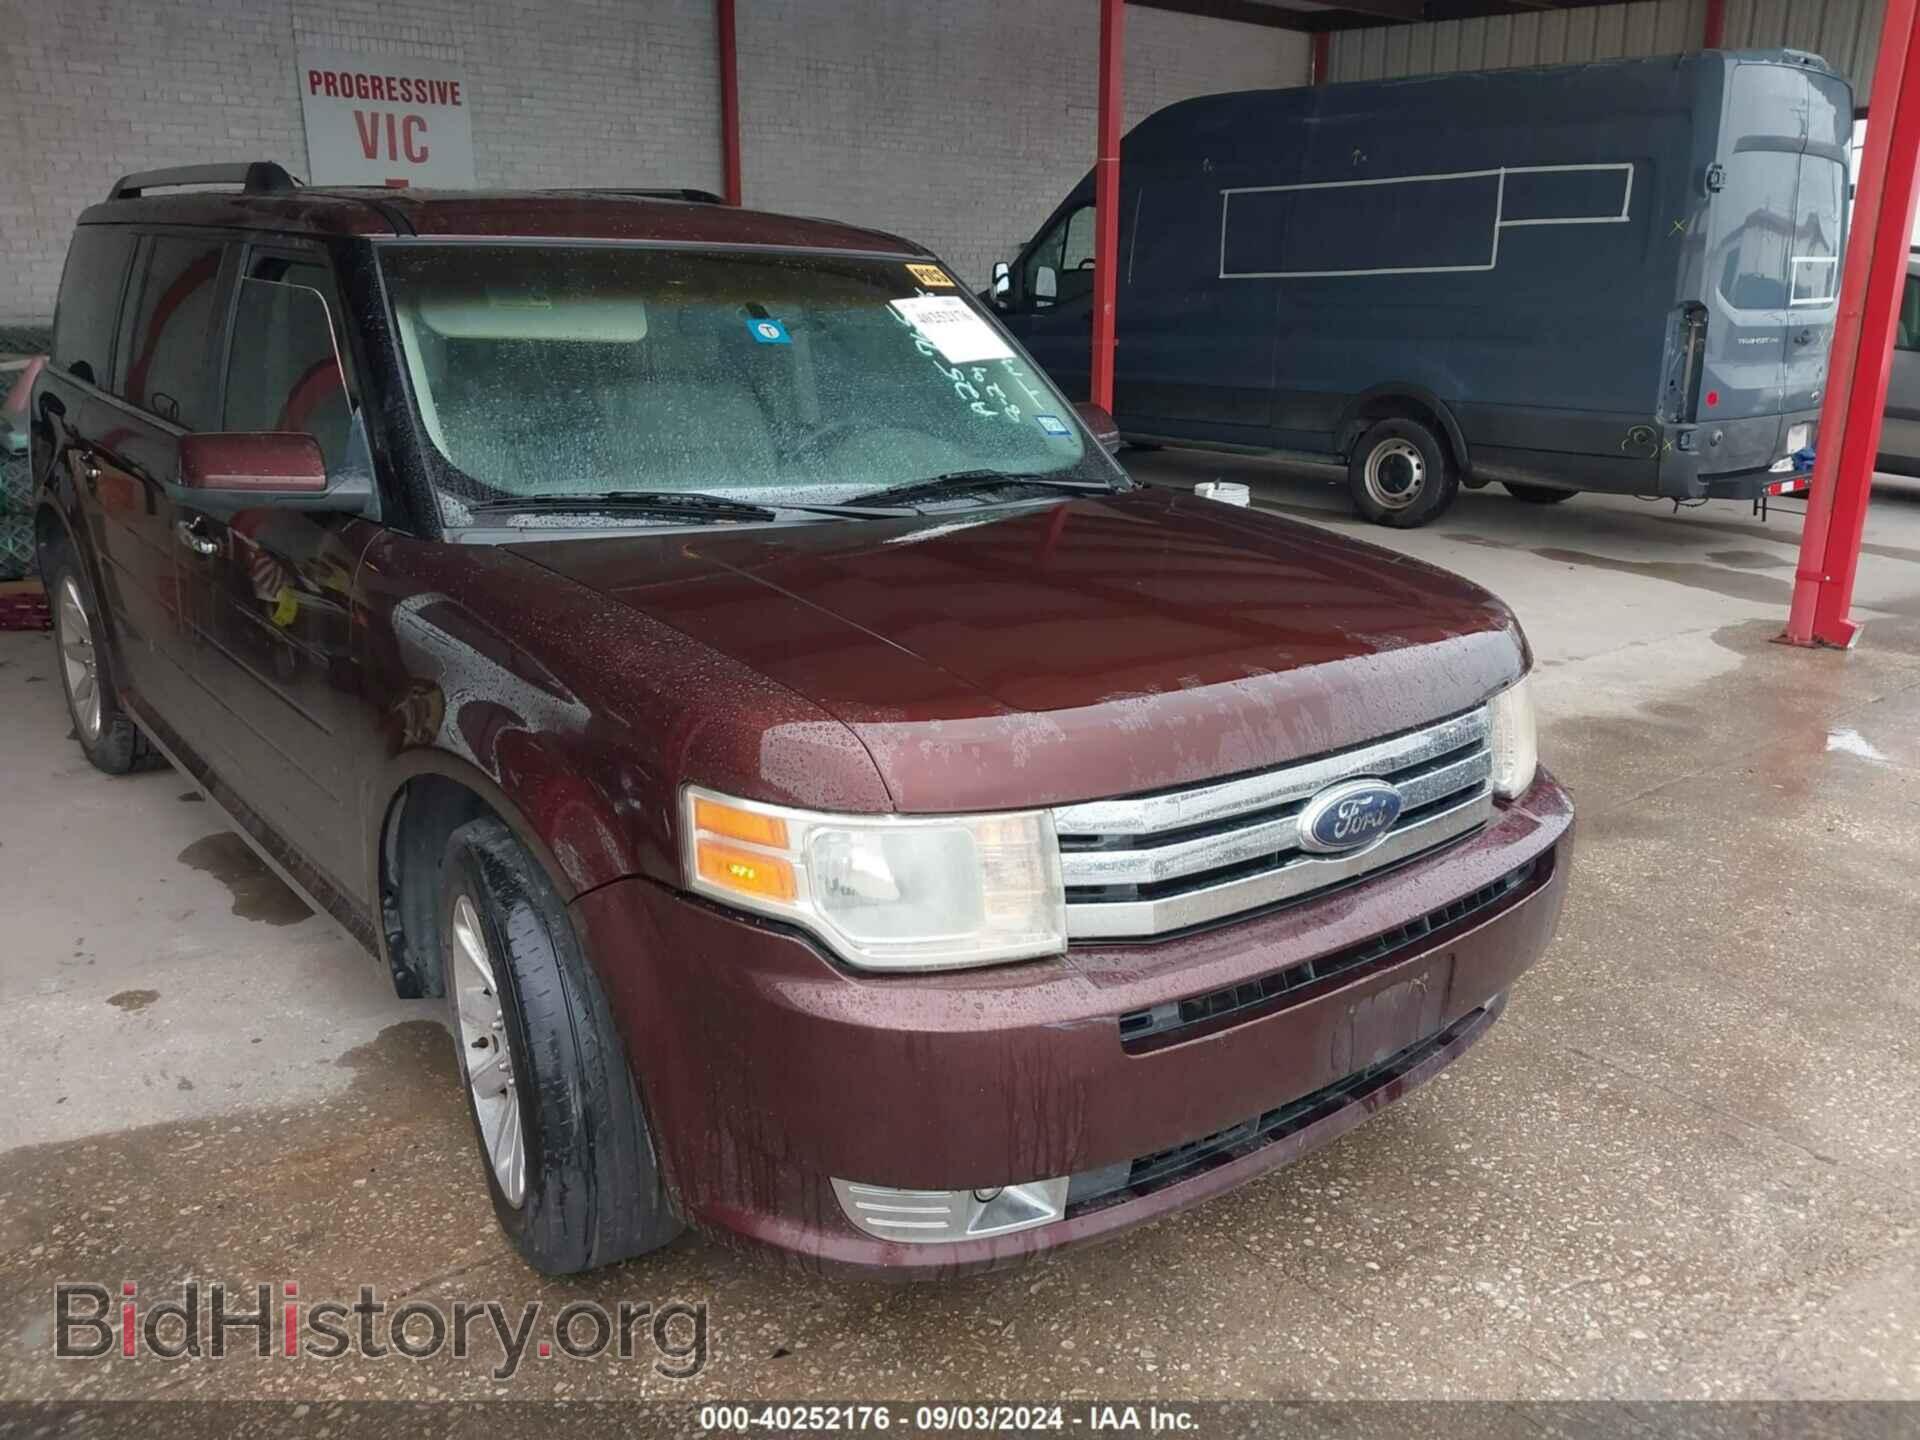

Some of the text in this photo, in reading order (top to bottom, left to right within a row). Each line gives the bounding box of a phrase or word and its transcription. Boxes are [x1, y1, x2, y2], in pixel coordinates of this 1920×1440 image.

[308, 70, 462, 106] PROGRESSIVE
[353, 110, 429, 163] VIC
[1334, 796, 1386, 838] Ford
